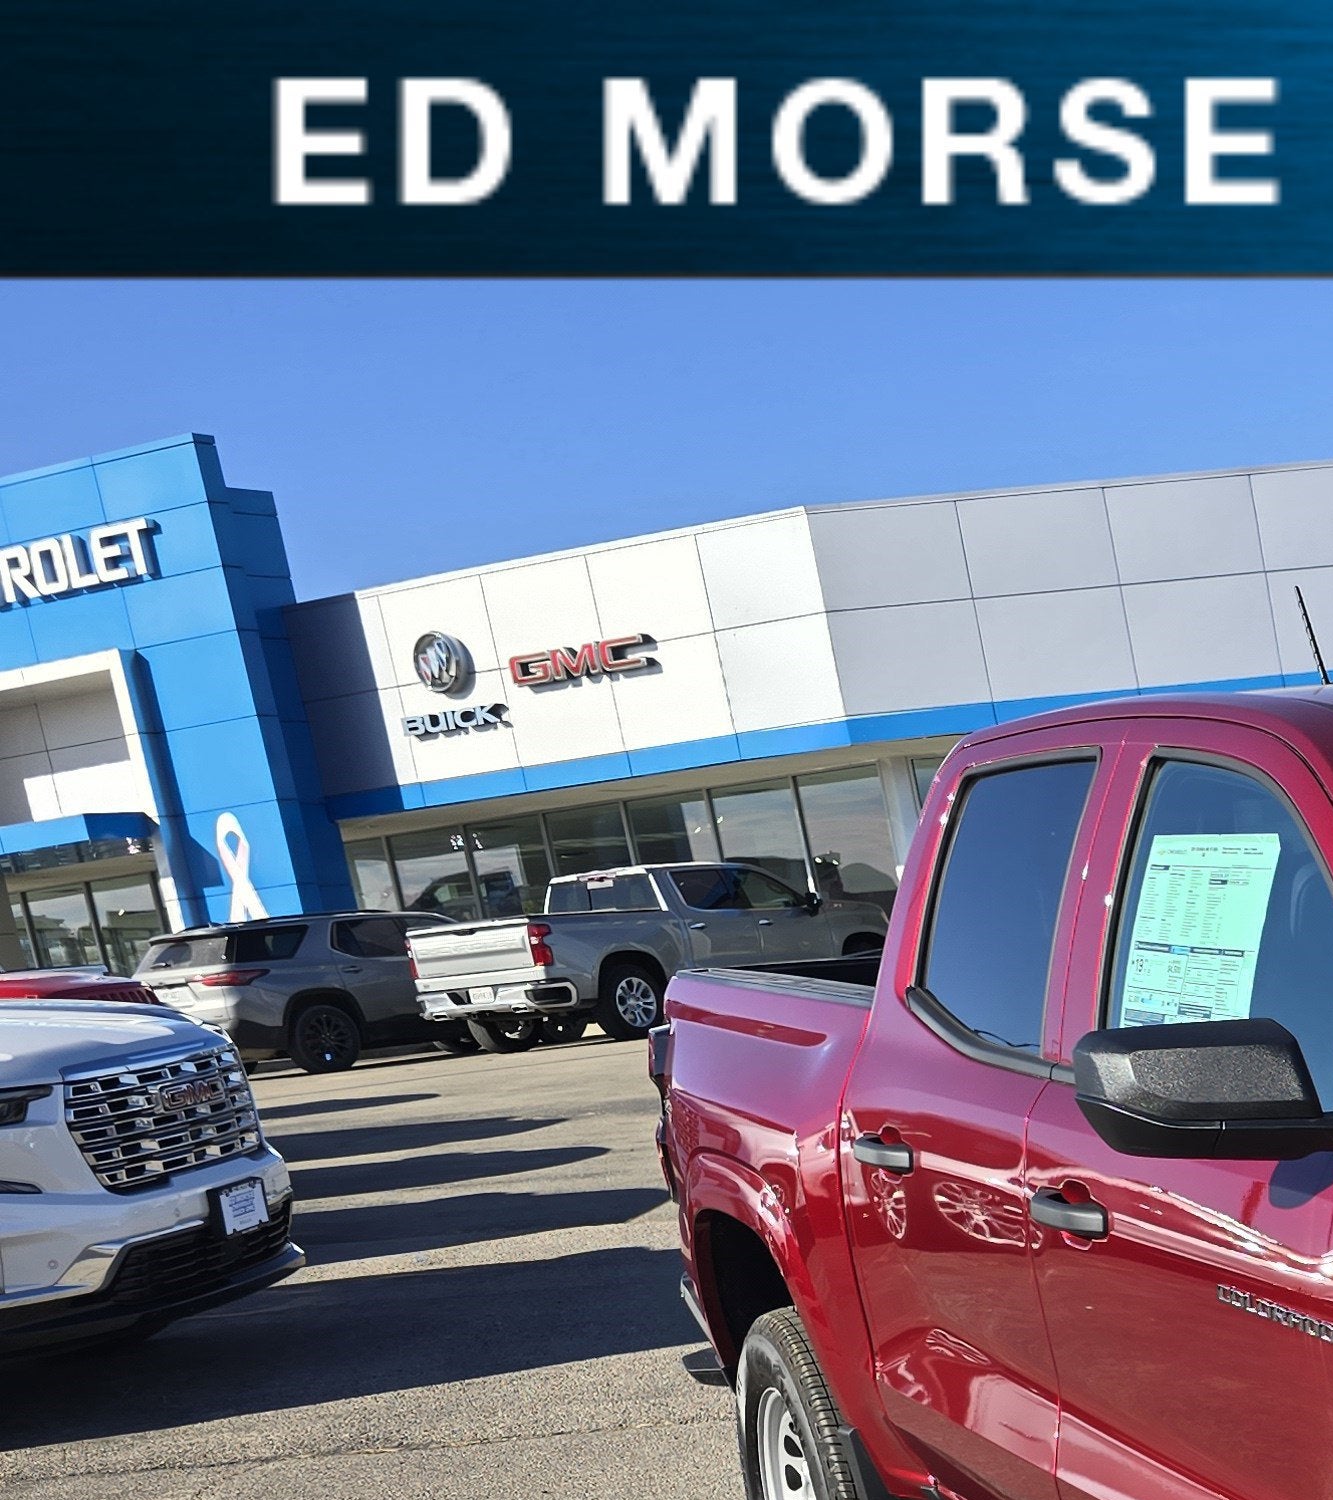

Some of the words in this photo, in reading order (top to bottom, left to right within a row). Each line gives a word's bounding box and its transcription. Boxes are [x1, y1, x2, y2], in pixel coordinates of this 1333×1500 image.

[508, 633, 648, 687] GMC
[402, 703, 501, 737] BUICK
[164, 1078, 225, 1110] GMC
